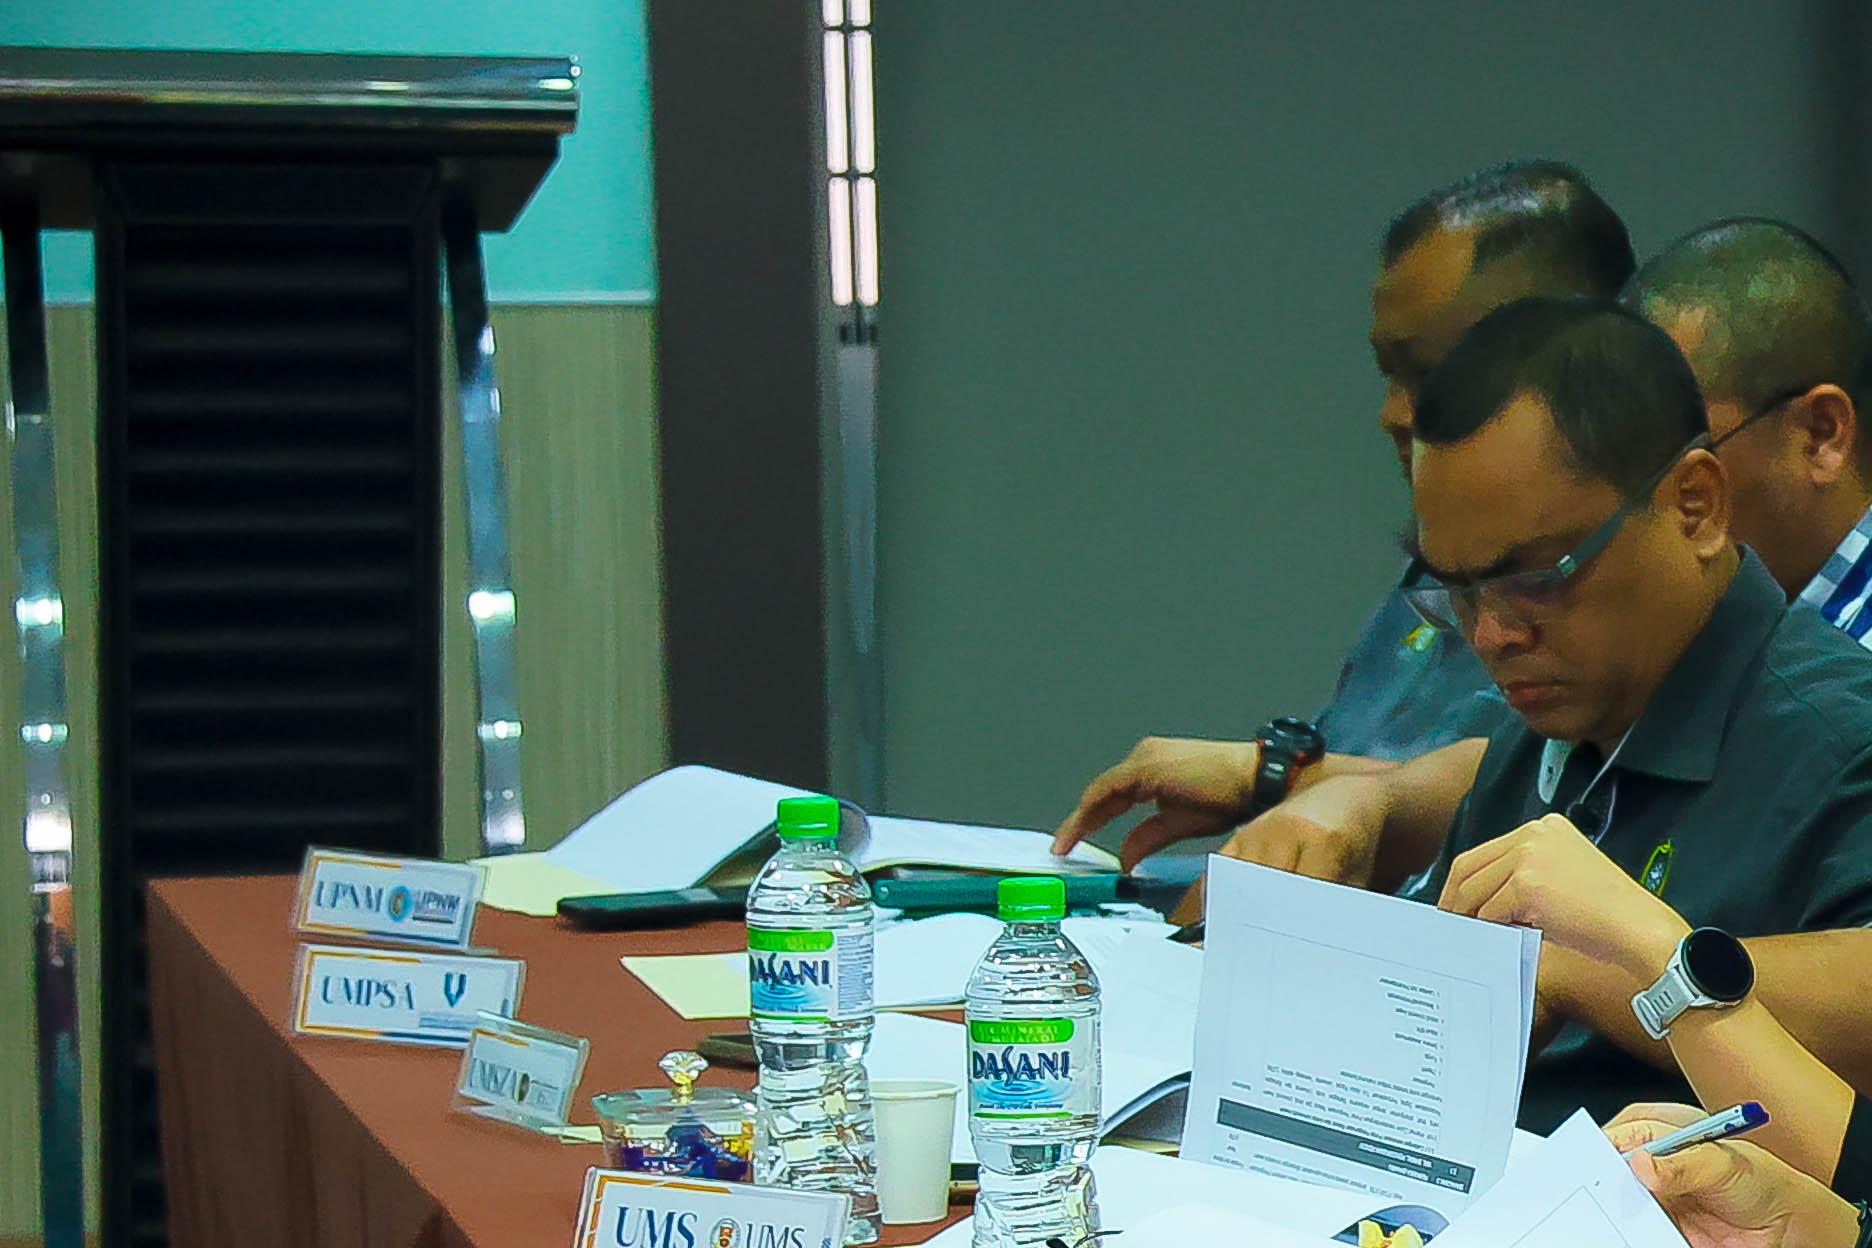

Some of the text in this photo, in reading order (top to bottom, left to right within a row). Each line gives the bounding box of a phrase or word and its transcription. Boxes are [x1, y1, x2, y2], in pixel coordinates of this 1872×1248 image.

[316, 880, 383, 912] UPNM
[321, 975, 416, 1010] UMPSA
[973, 1046, 1070, 1086] DASANI
